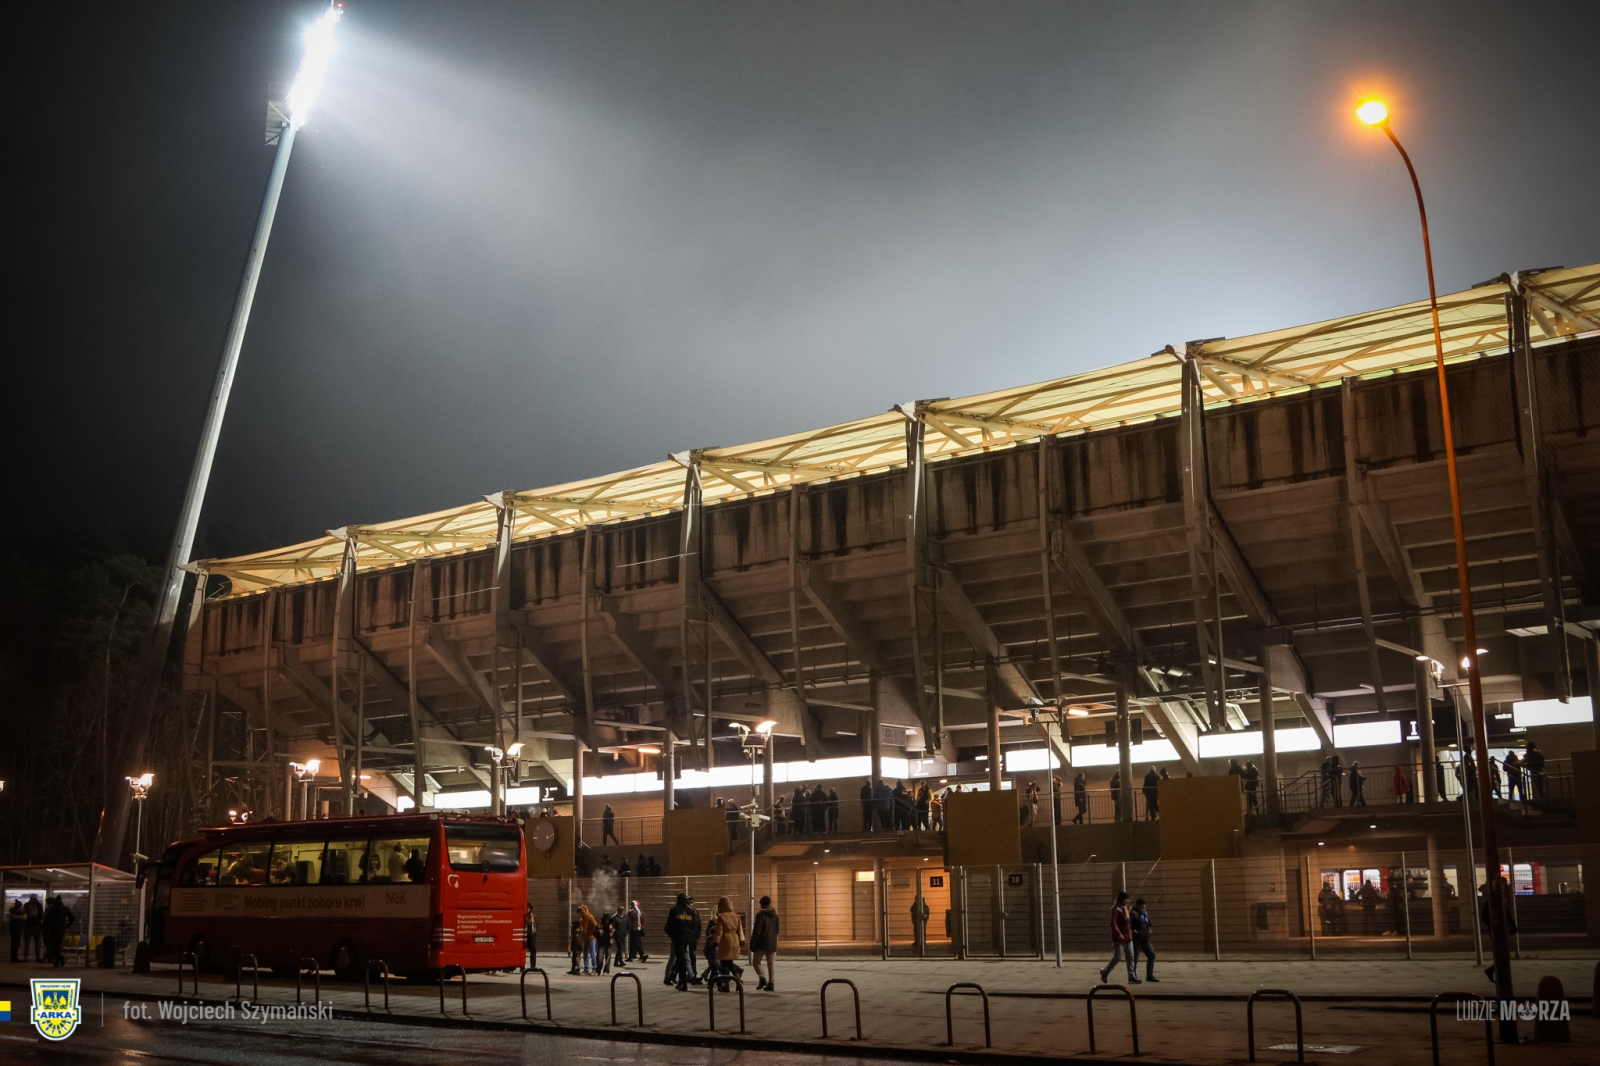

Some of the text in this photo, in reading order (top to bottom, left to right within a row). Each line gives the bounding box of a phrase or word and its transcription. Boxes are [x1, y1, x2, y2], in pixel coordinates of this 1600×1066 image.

[932, 878, 941, 886] 11
[1011, 876, 1020, 884] 10
[244, 896, 277, 911] Mobilny
[279, 896, 306, 911] punkt
[308, 895, 342, 911] poboru
[344, 895, 366, 908] krwi
